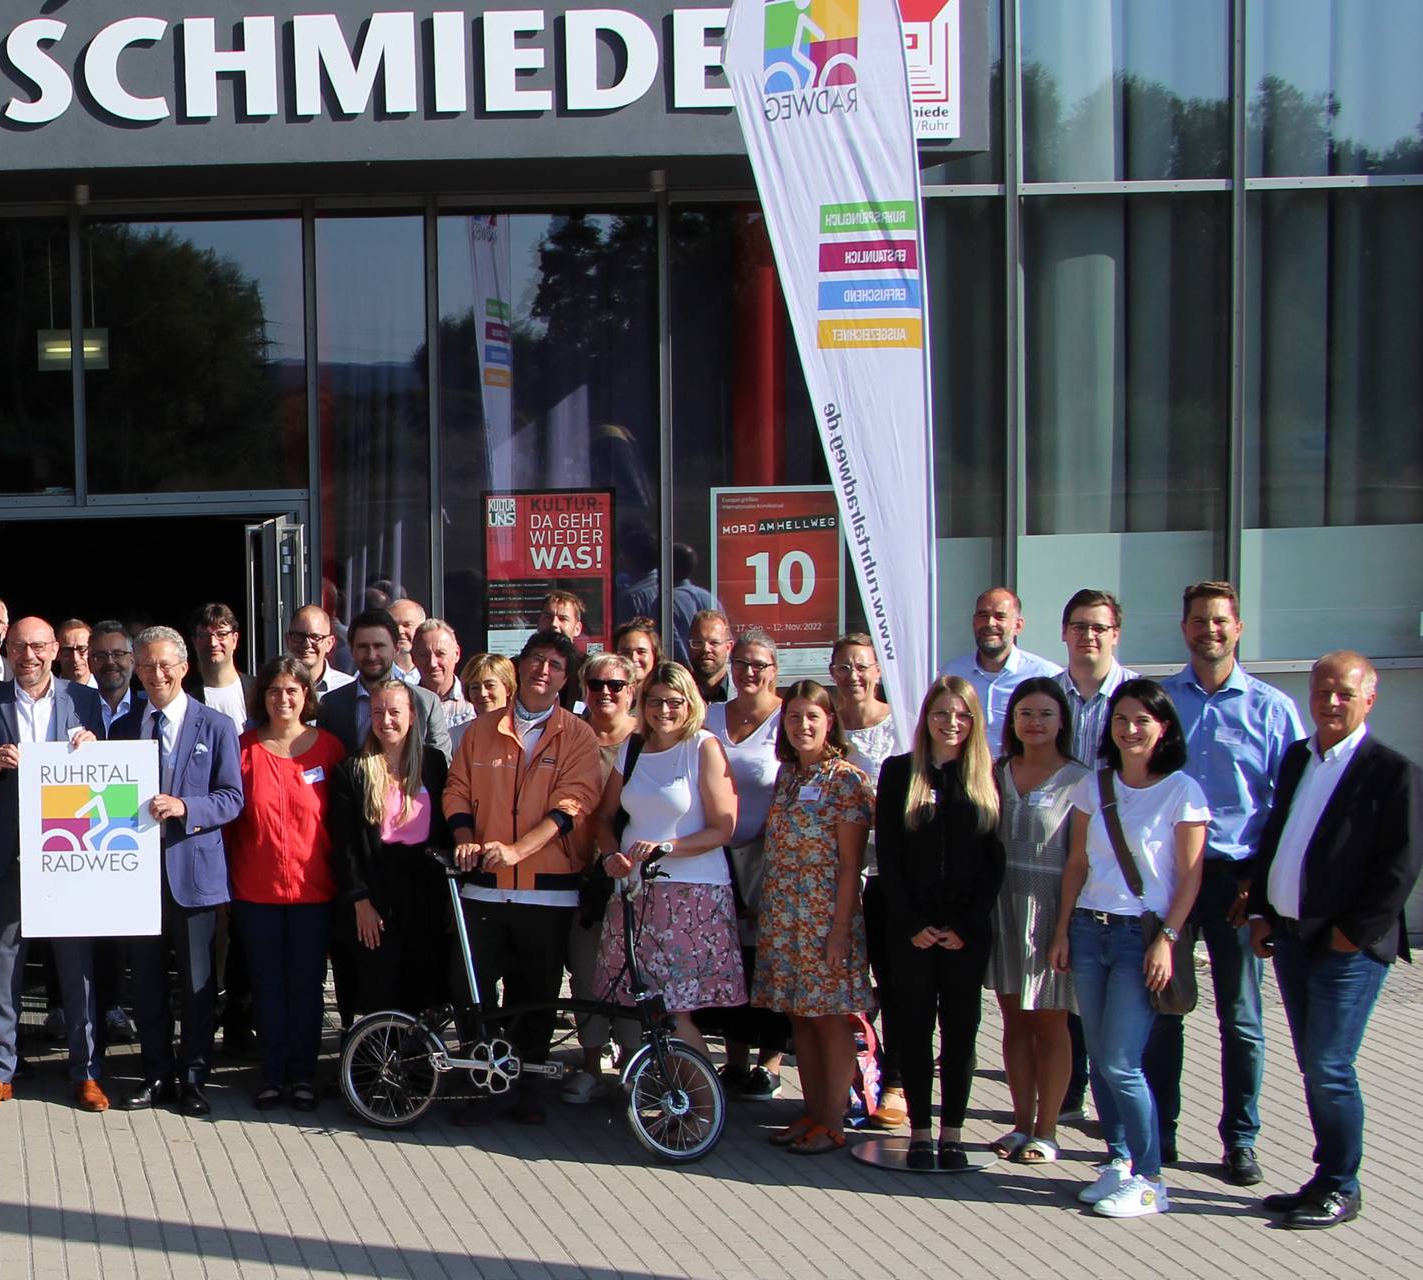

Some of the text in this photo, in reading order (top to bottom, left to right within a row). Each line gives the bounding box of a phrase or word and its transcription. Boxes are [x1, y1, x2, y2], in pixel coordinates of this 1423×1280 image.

[530, 497, 604, 512] KULTUR:
[530, 513, 604, 529] DA GEHT
[530, 530, 604, 545] WIEDER
[530, 546, 603, 570] WAS!
[744, 550, 816, 605] 10
[40, 764, 138, 784] RUHRTAL
[42, 853, 139, 873] RADWEG
